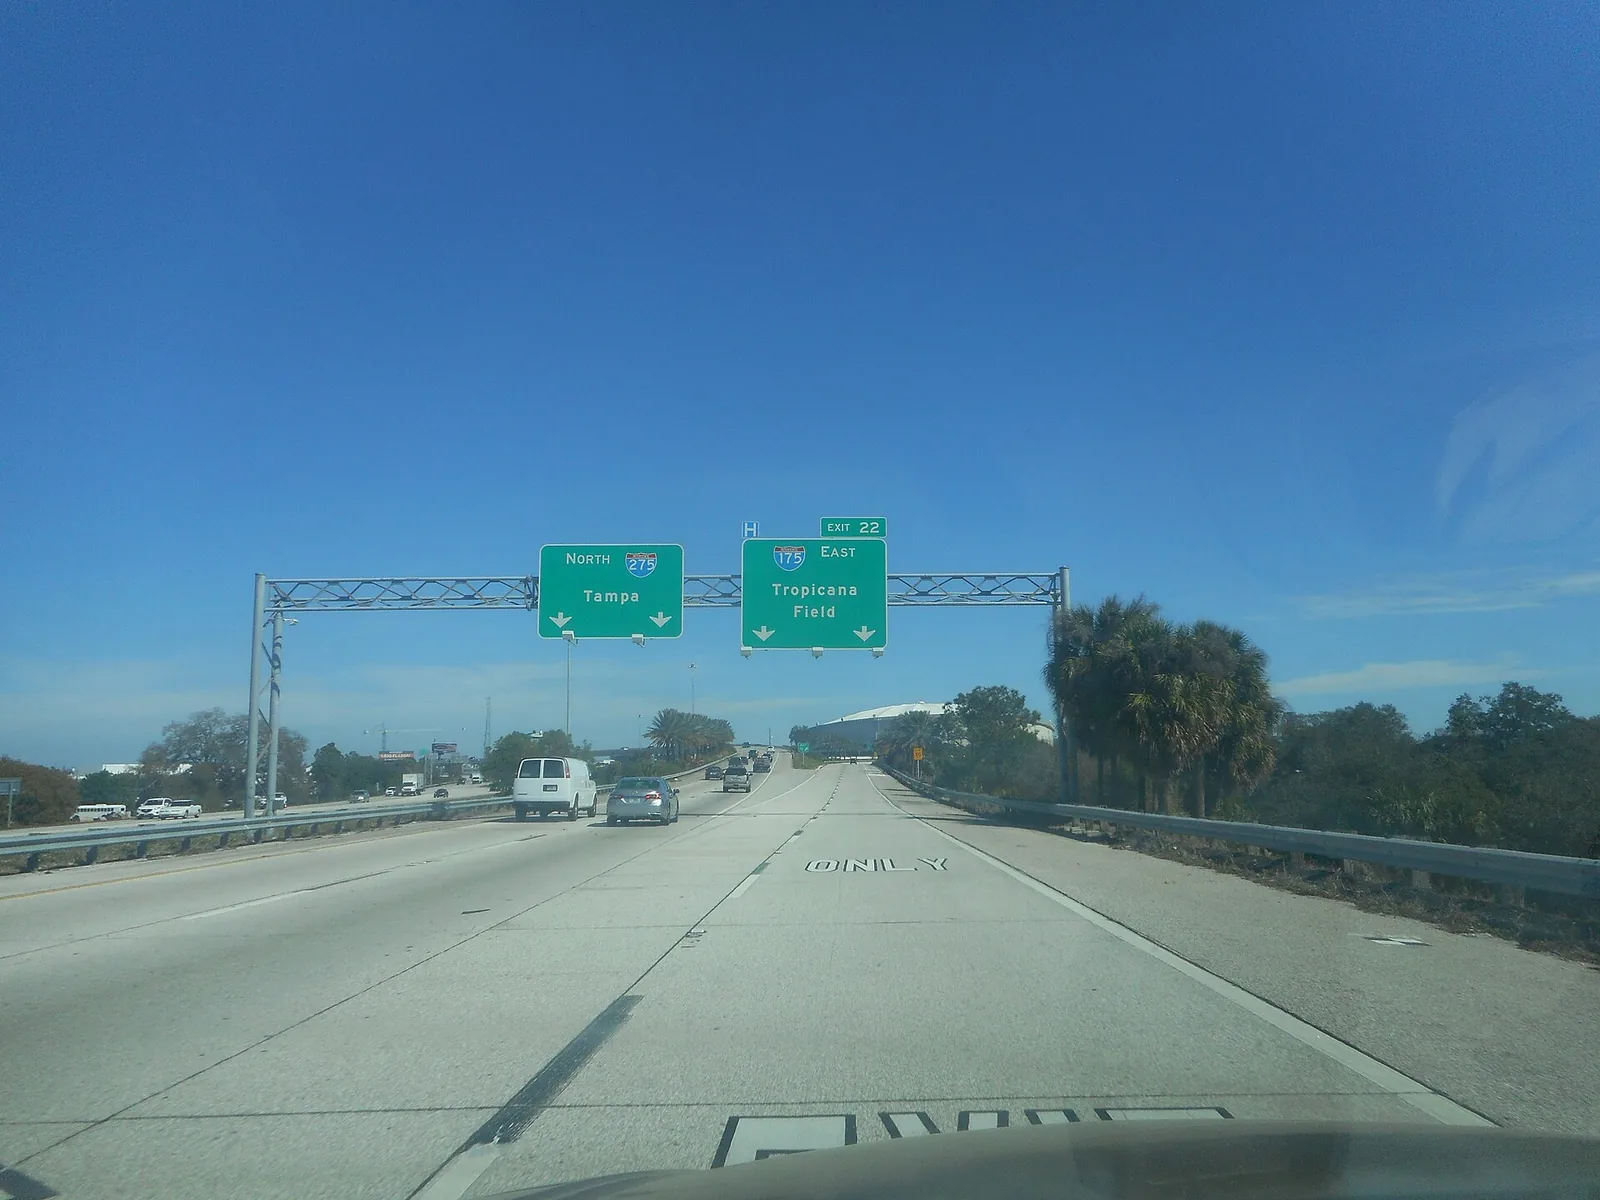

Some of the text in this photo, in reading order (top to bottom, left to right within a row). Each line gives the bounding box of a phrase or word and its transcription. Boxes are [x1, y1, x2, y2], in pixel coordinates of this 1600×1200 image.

[743, 522, 757, 537] H
[827, 522, 880, 533] EXIT 22
[779, 552, 802, 564] 175
[821, 546, 856, 558] EAST
[566, 553, 610, 564] NORTH
[629, 559, 655, 571] 275
[772, 583, 857, 599] Tropicana
[583, 590, 639, 605] Tampa
[793, 606, 835, 618] Field
[804, 857, 948, 873] ONLY
